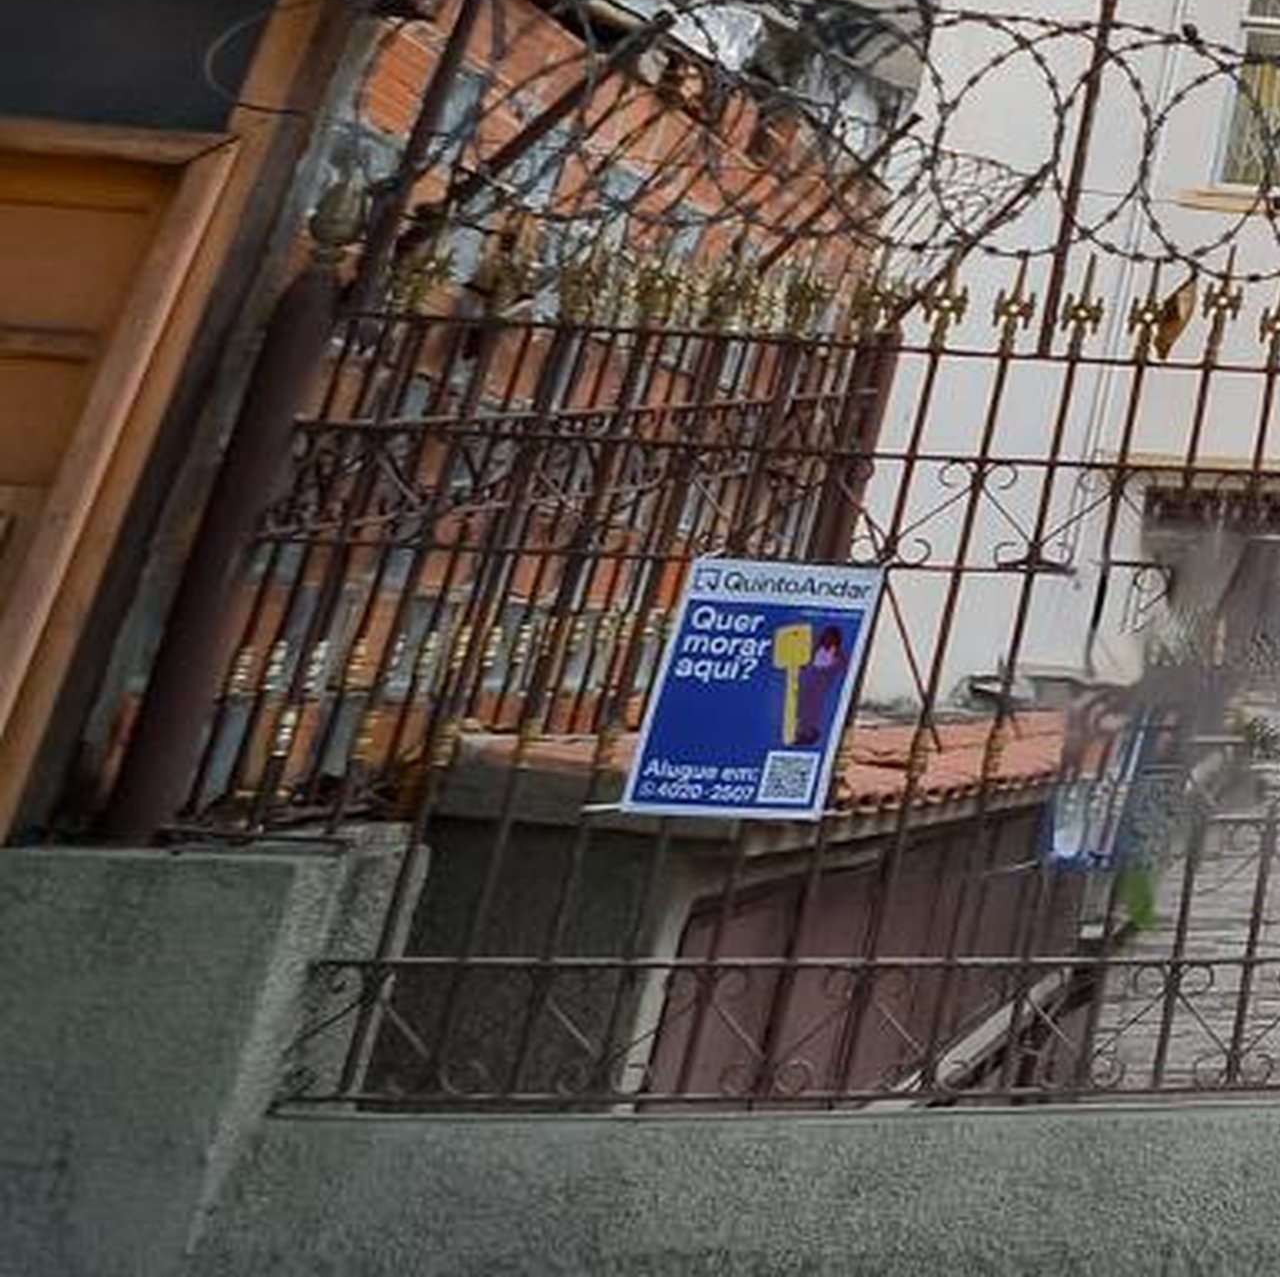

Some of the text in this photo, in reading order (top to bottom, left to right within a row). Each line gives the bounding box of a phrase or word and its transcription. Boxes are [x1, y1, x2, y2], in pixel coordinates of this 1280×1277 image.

[723, 570, 873, 600] QuintoAndar
[690, 605, 766, 633] Quer
[682, 633, 772, 658] morar
[674, 656, 759, 684] aqui?
[642, 759, 718, 783] Alugue
